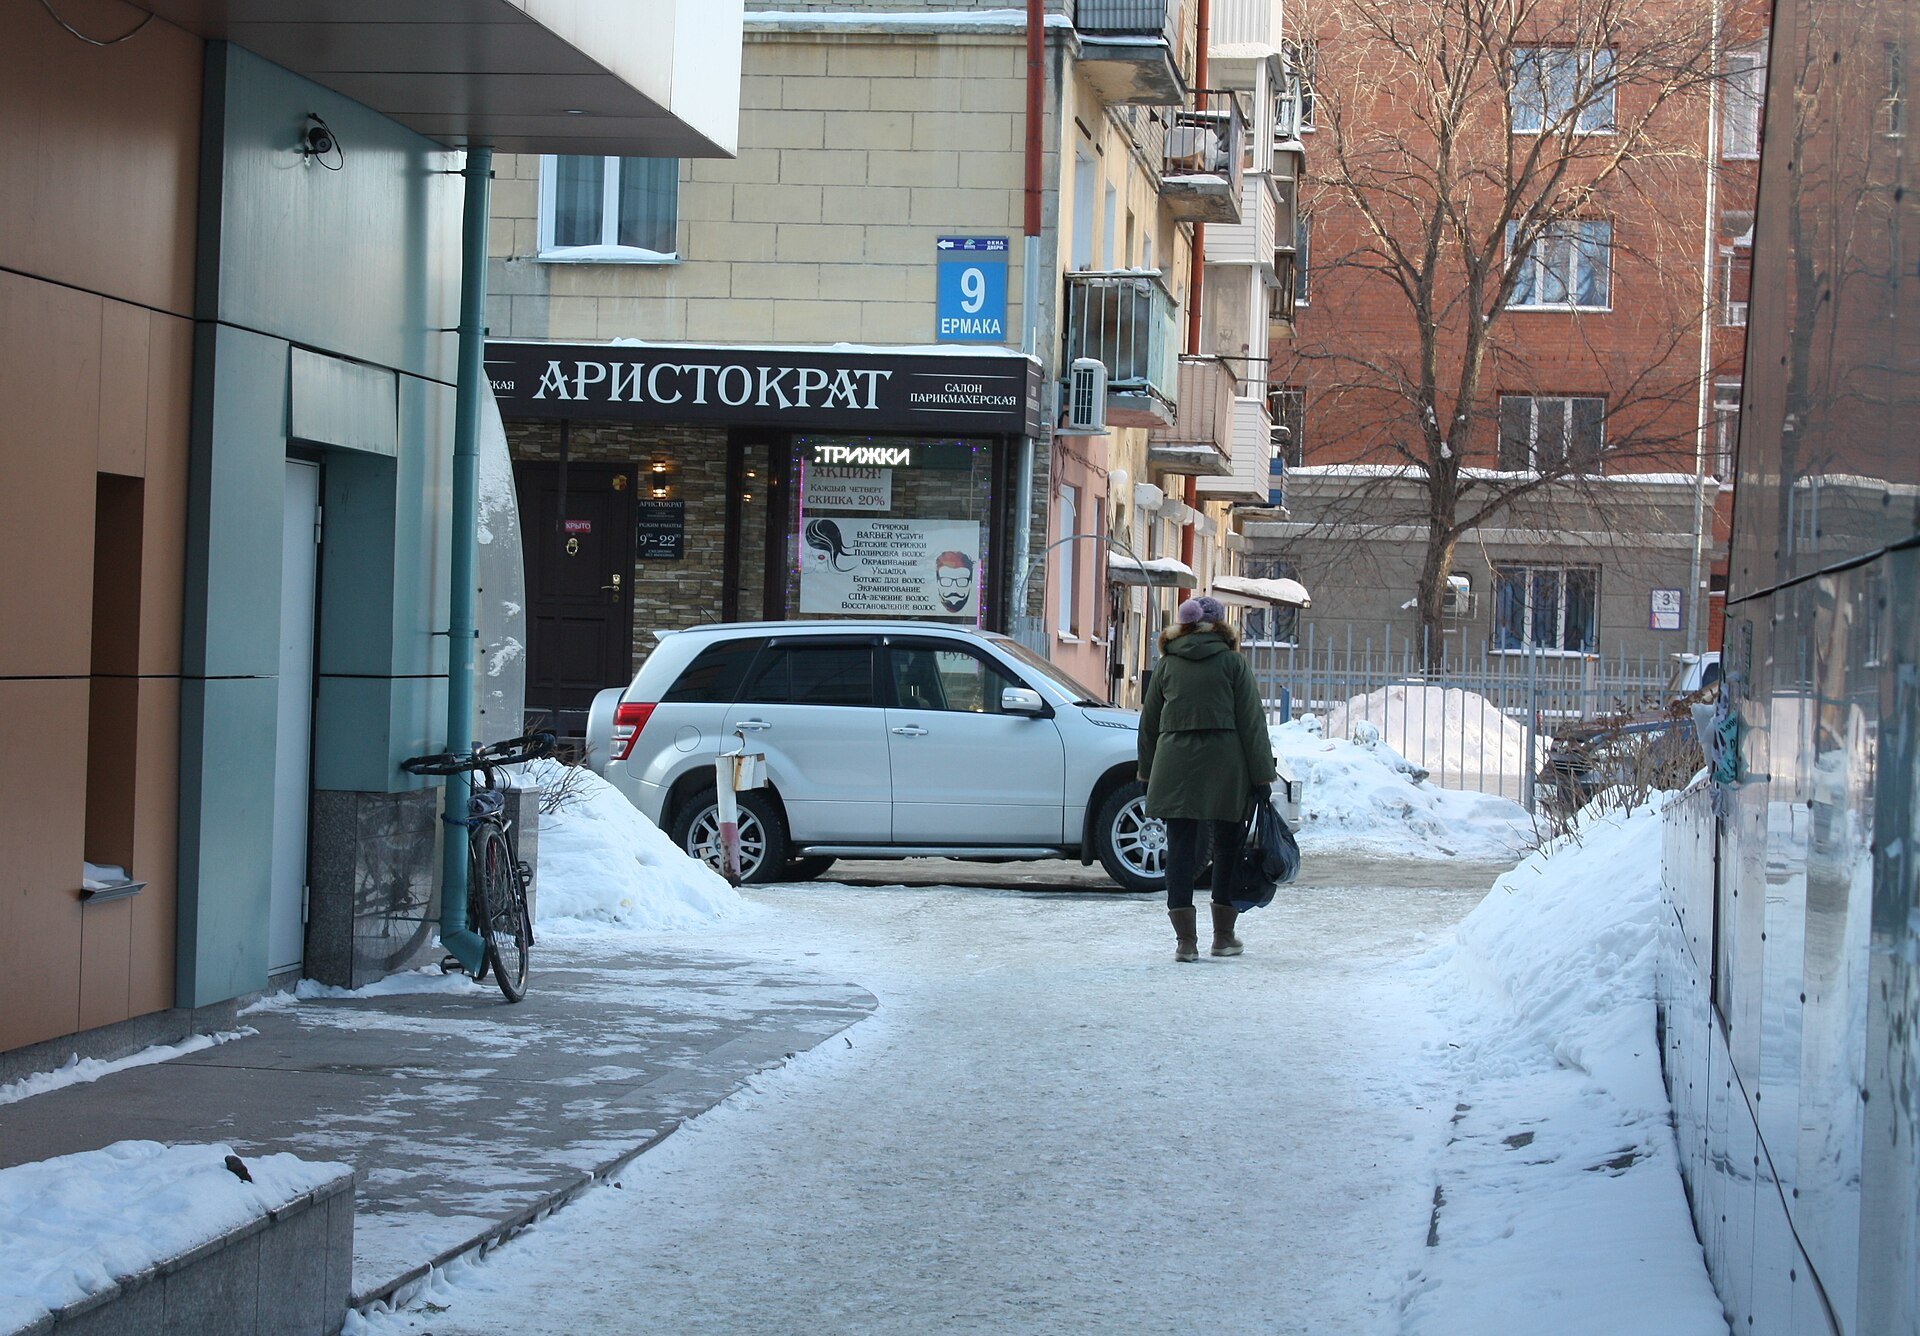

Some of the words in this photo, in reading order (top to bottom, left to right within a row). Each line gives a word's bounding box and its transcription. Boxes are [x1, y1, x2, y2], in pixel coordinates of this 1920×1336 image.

[960, 267, 986, 314] 9
[941, 318, 1002, 334] ЕРМАКА
[532, 360, 893, 410] АРИСТОКРАТ
[944, 383, 983, 393] САЛОН
[910, 393, 1017, 406] ПАРИКМАХЕРСКАЯ
[807, 495, 854, 505] СКИДКА
[858, 495, 885, 506] 20%
[856, 531, 893, 539] BARBER
[1662, 593, 1670, 606] 3
